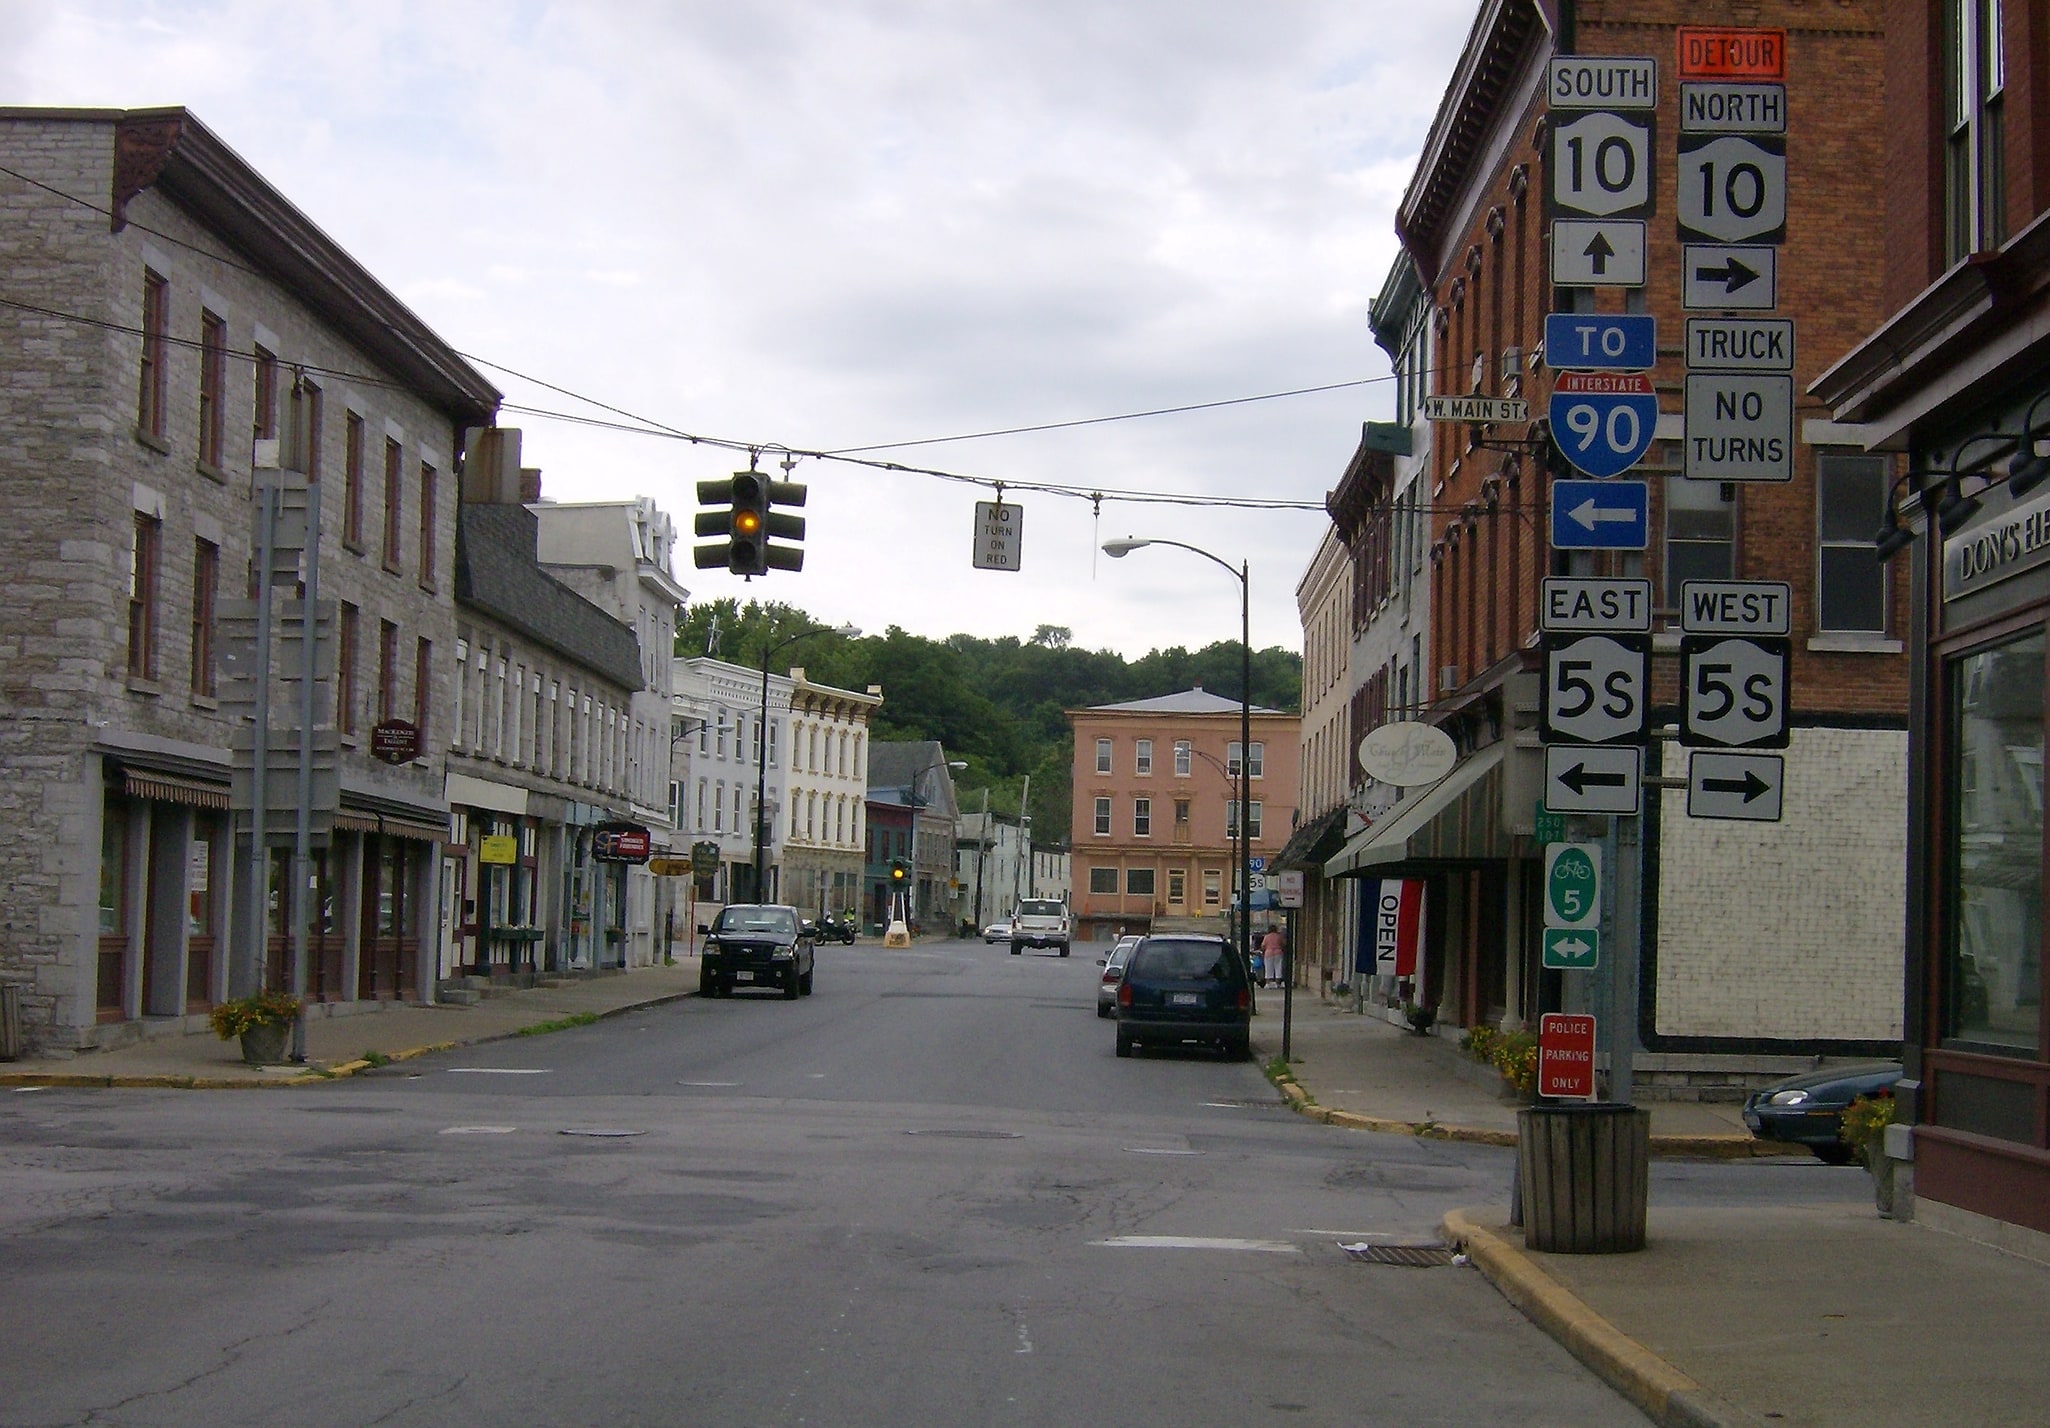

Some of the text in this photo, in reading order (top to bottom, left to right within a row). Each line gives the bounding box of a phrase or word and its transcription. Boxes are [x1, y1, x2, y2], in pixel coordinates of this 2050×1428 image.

[1689, 38, 1774, 67] DETOUR
[1555, 68, 1649, 98] SOUTH
[1689, 93, 1779, 122] NORTH
[1567, 135, 1636, 193] 10
[1699, 161, 1766, 219] 10
[1575, 326, 1626, 357] TO
[1696, 329, 1784, 360] TRUCK
[1566, 377, 1642, 392] INTERSTATE
[1433, 400, 1522, 420] W. MAIN ST.
[1715, 391, 1763, 422] NO
[1566, 404, 1640, 454] 90
[1693, 436, 1784, 463] TURNS
[988, 508, 1010, 522] NO
[984, 525, 1013, 537] TURN
[990, 540, 1005, 550] ON
[986, 553, 1007, 565] RED
[1961, 522, 2020, 581] DON'S
[1550, 589, 1642, 620] EAST
[1693, 592, 1779, 623] WEST
[1557, 660, 1634, 720] 5S
[1697, 663, 1774, 723] 5S
[1250, 858, 1263, 869] 90
[1563, 889, 1581, 916] 5
[1378, 895, 1399, 961] OPEN
[1549, 1022, 1588, 1034] POLICE
[1546, 1049, 1589, 1062] PARKING
[1552, 1077, 1580, 1089] ONLY
